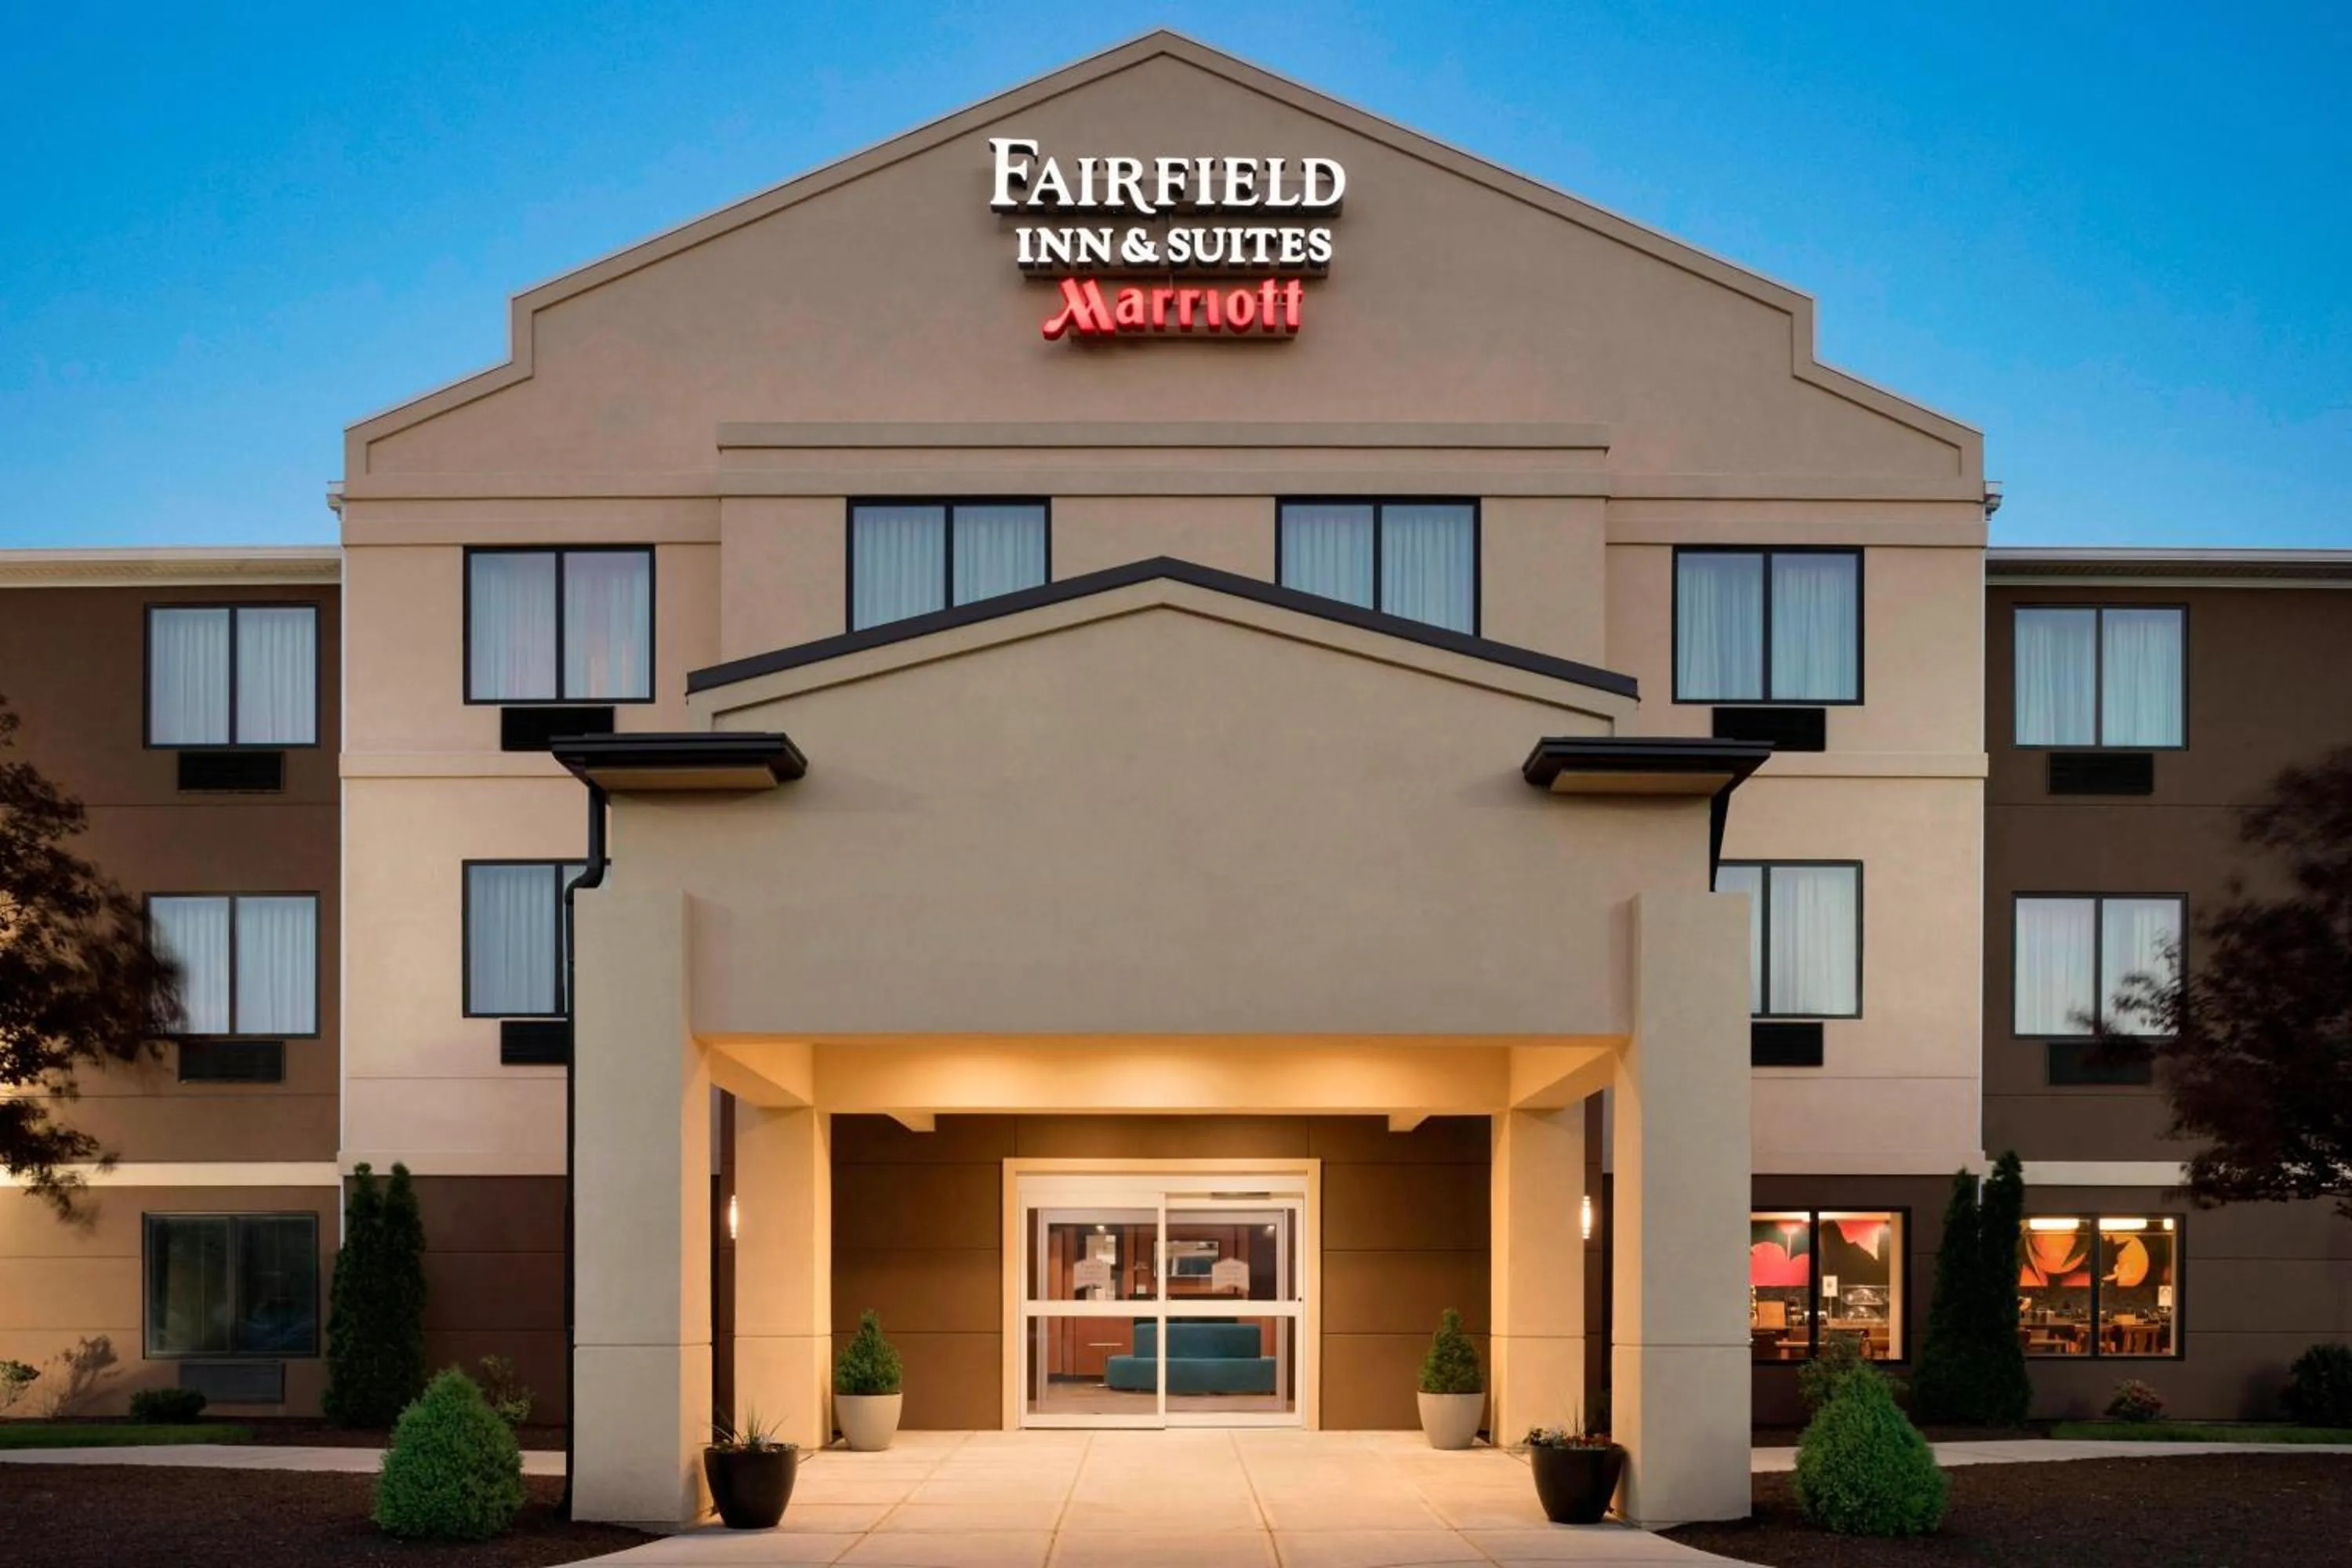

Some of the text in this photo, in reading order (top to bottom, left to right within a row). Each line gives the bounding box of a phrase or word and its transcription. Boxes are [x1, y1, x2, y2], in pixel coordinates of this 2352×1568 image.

[989, 137, 1346, 215] FAIRFIELD
[1016, 227, 1333, 264] INN & SUITES
[1042, 278, 1303, 340] Marriott
